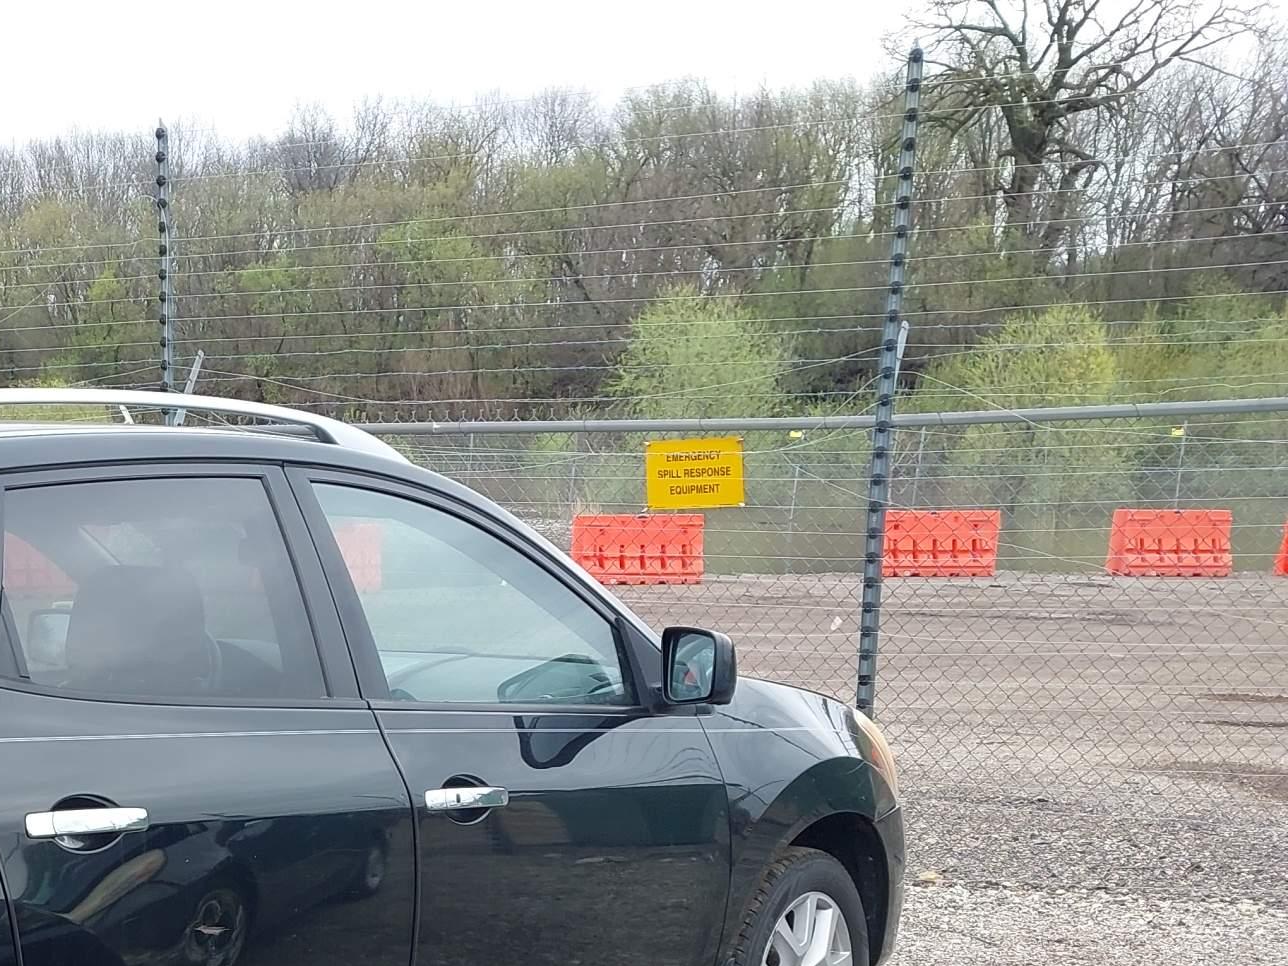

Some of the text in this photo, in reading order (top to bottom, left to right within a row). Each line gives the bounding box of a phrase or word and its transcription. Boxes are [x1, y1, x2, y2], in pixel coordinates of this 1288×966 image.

[665, 450, 721, 463] EMERGENCY
[657, 466, 732, 479] SPILL RESPONSE
[669, 483, 721, 495] EQUIPMENT
